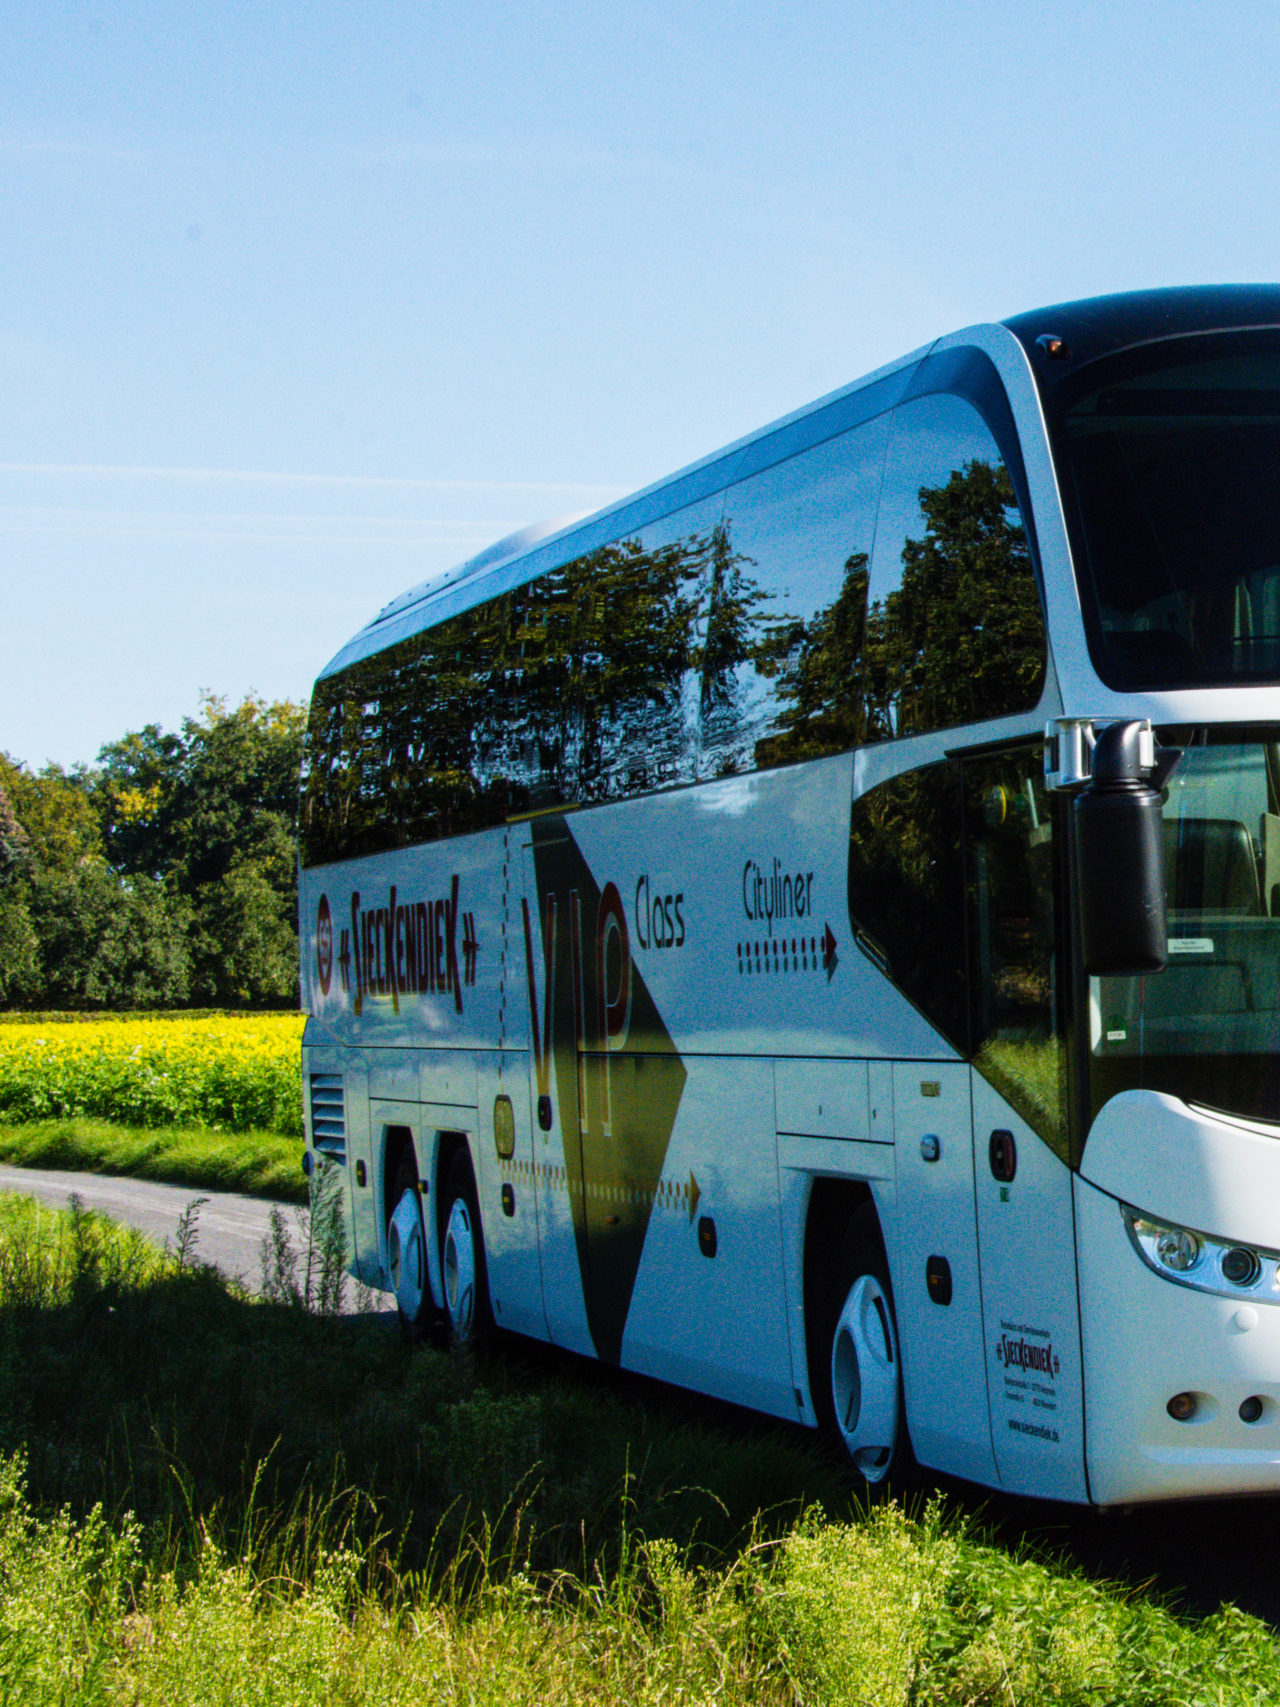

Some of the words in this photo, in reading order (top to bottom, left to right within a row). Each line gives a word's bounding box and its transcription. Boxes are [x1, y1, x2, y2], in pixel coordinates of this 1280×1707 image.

[743, 857, 813, 938] Cityliner
[521, 881, 632, 1137] VIP
[635, 874, 685, 950] Class
